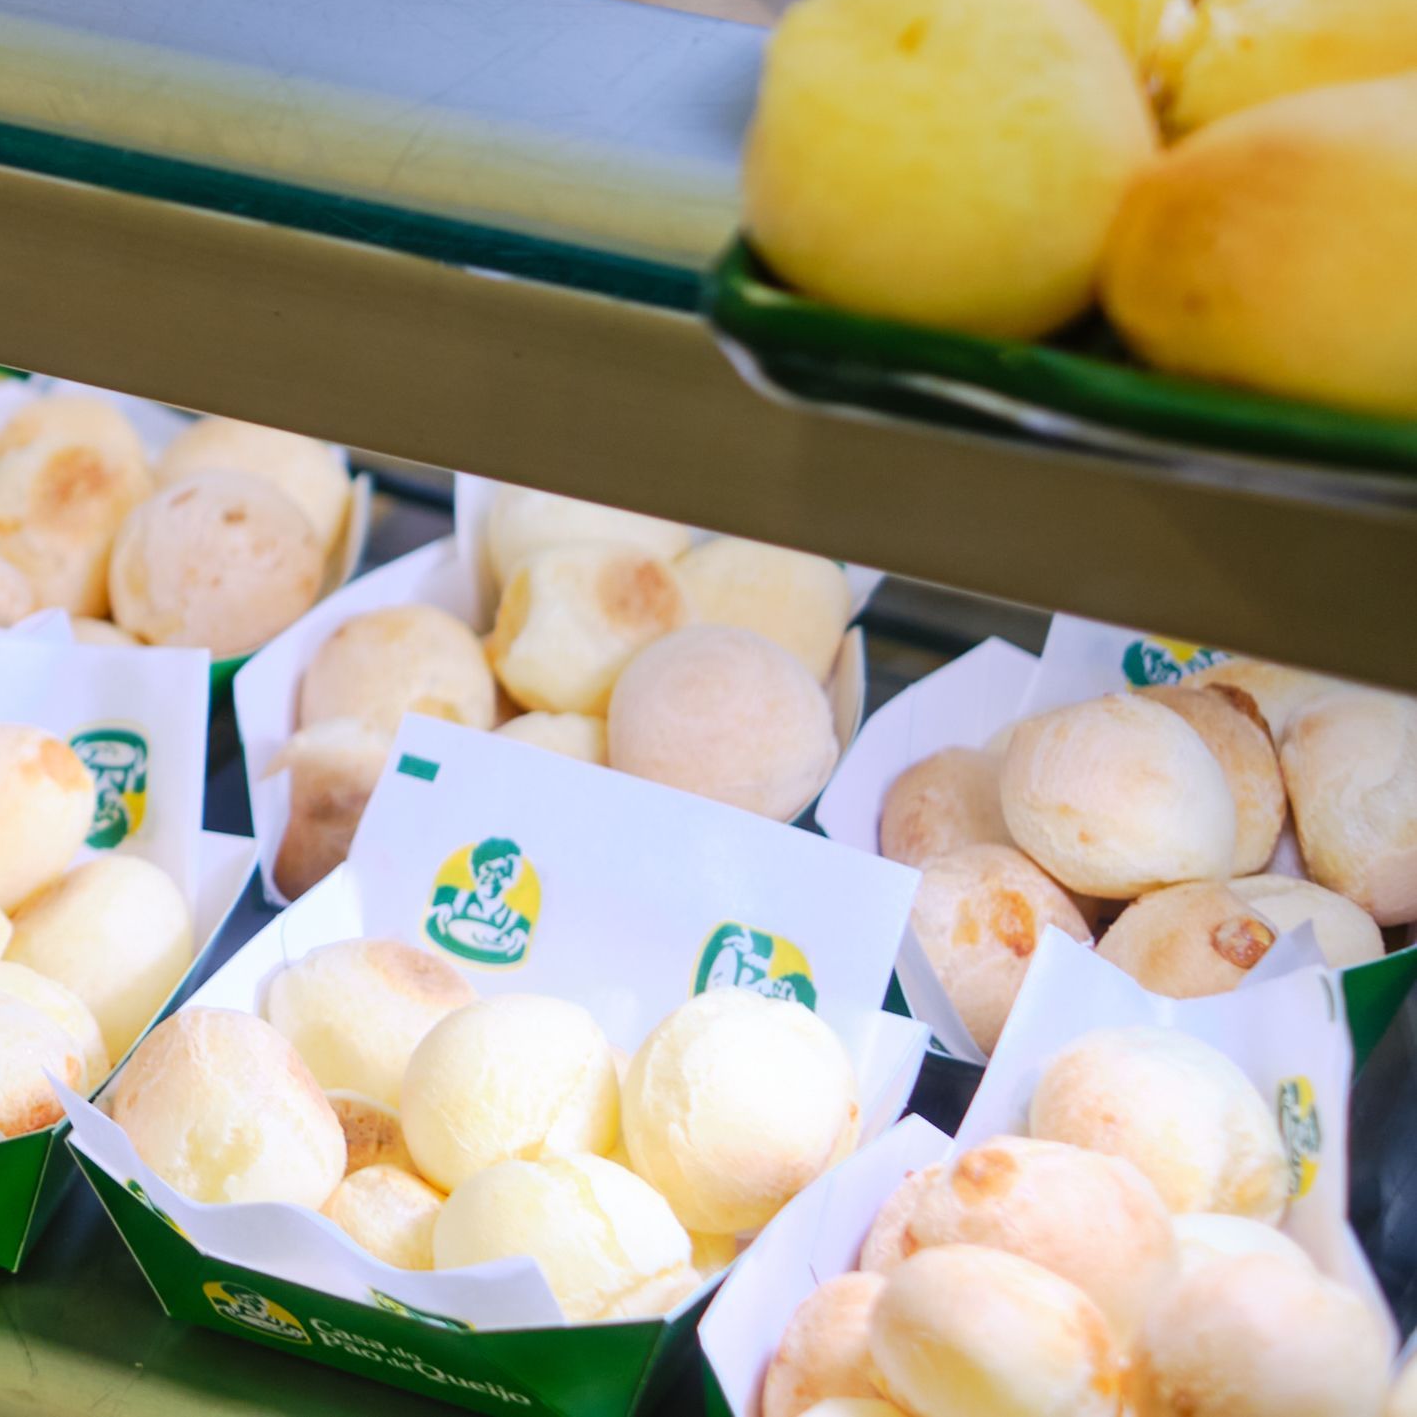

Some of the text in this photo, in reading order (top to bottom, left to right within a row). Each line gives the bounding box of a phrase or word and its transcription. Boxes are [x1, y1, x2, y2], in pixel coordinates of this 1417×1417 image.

[309, 1318, 422, 1363] Casa do
[385, 1357, 414, 1372] de
[413, 1361, 532, 1405] Queijo
